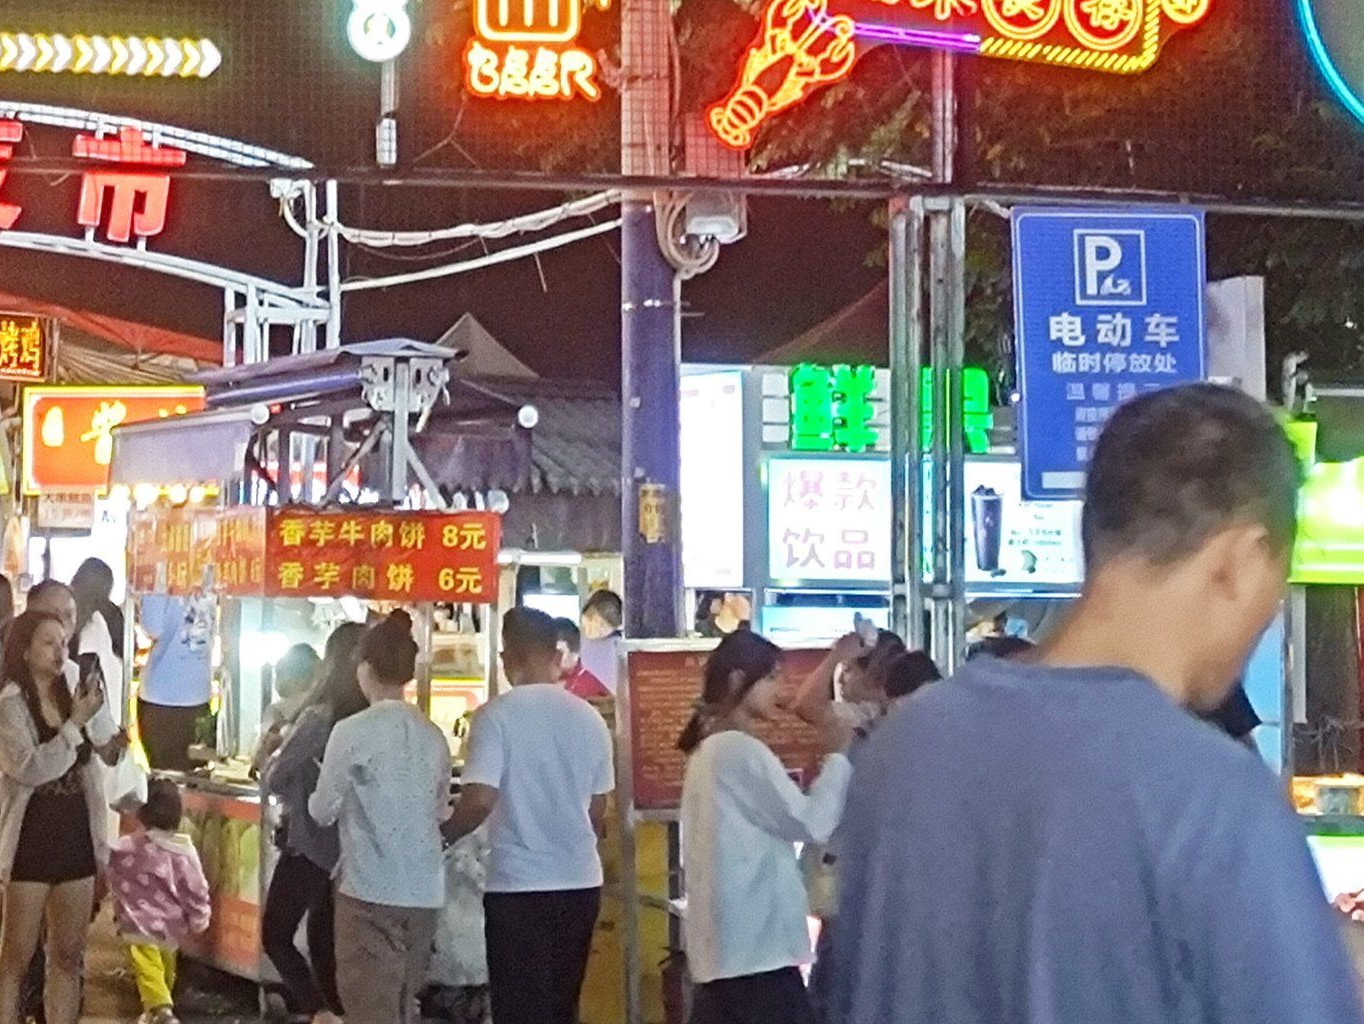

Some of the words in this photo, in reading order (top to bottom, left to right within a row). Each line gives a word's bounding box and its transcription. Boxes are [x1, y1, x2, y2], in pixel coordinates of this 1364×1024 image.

[467, 42, 599, 101] BEER
[1048, 312, 1180, 348] 电动车
[1052, 352, 1178, 374] 临时停放处
[782, 470, 877, 511] 爆款
[279, 519, 426, 550] 香芋牛肉饼
[441, 522, 488, 551] 8元
[782, 527, 876, 570] 饮品
[277, 562, 414, 591] 香芋肉饼
[438, 567, 483, 594] 6元
